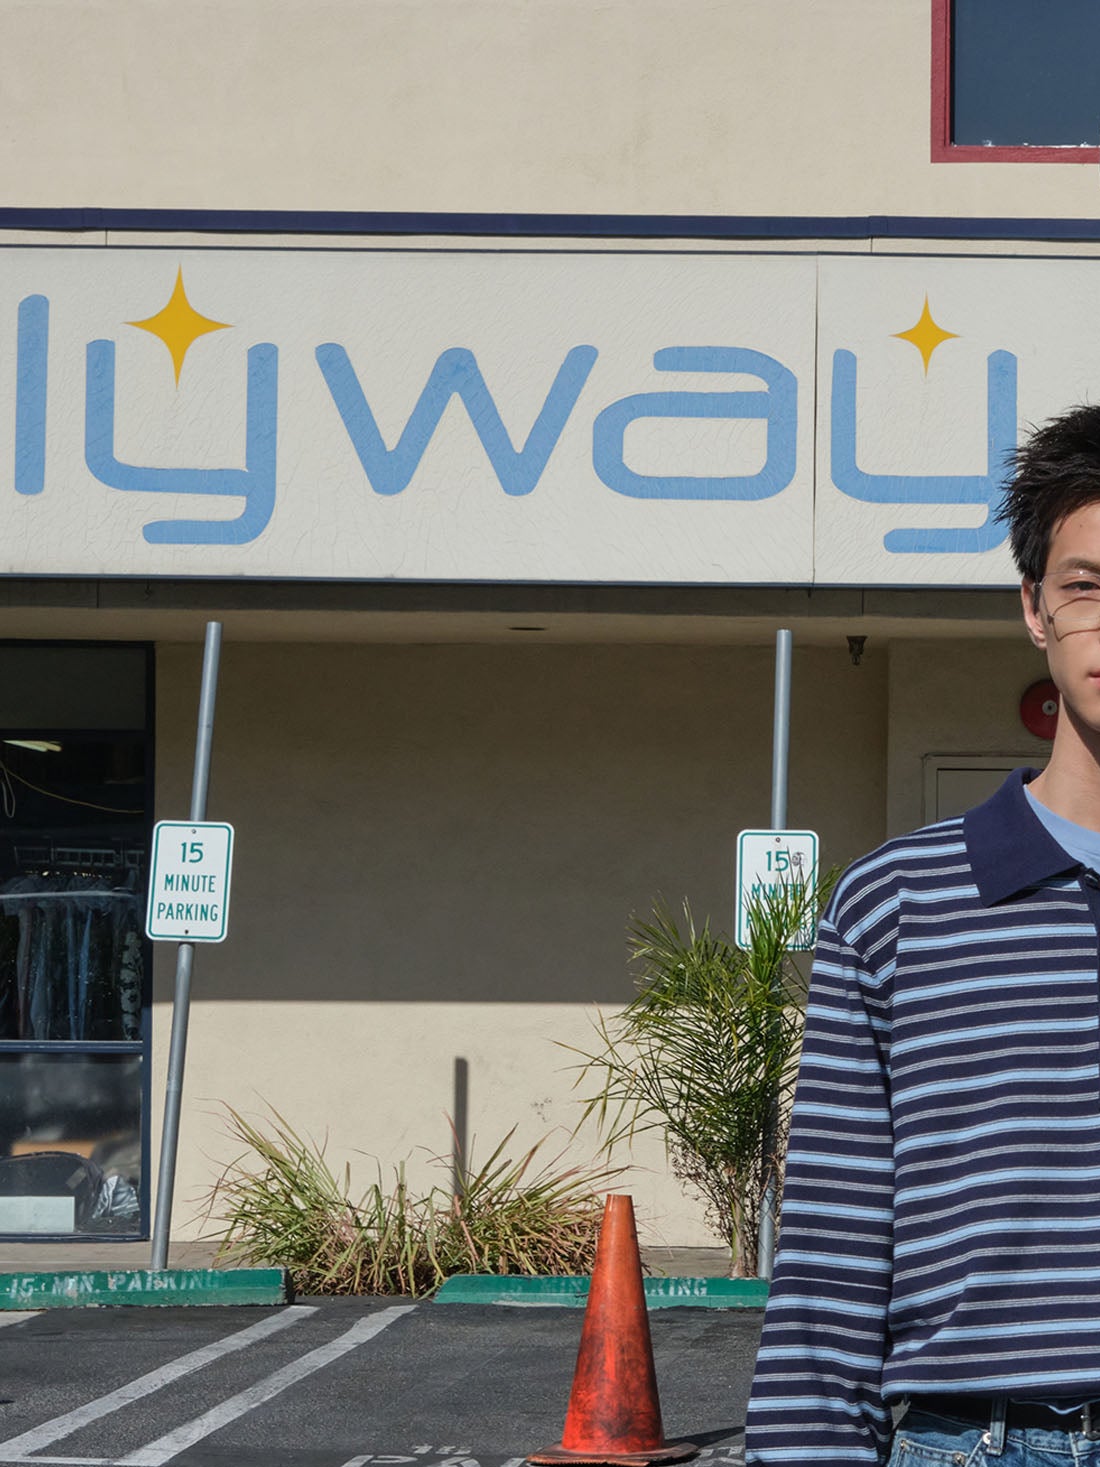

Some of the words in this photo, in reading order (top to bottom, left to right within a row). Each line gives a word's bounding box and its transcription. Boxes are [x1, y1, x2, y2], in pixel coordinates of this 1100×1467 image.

[180, 841, 204, 864] 15
[765, 850, 789, 872] 15
[163, 873, 217, 893] MINUTE
[156, 901, 219, 922] PARKING
